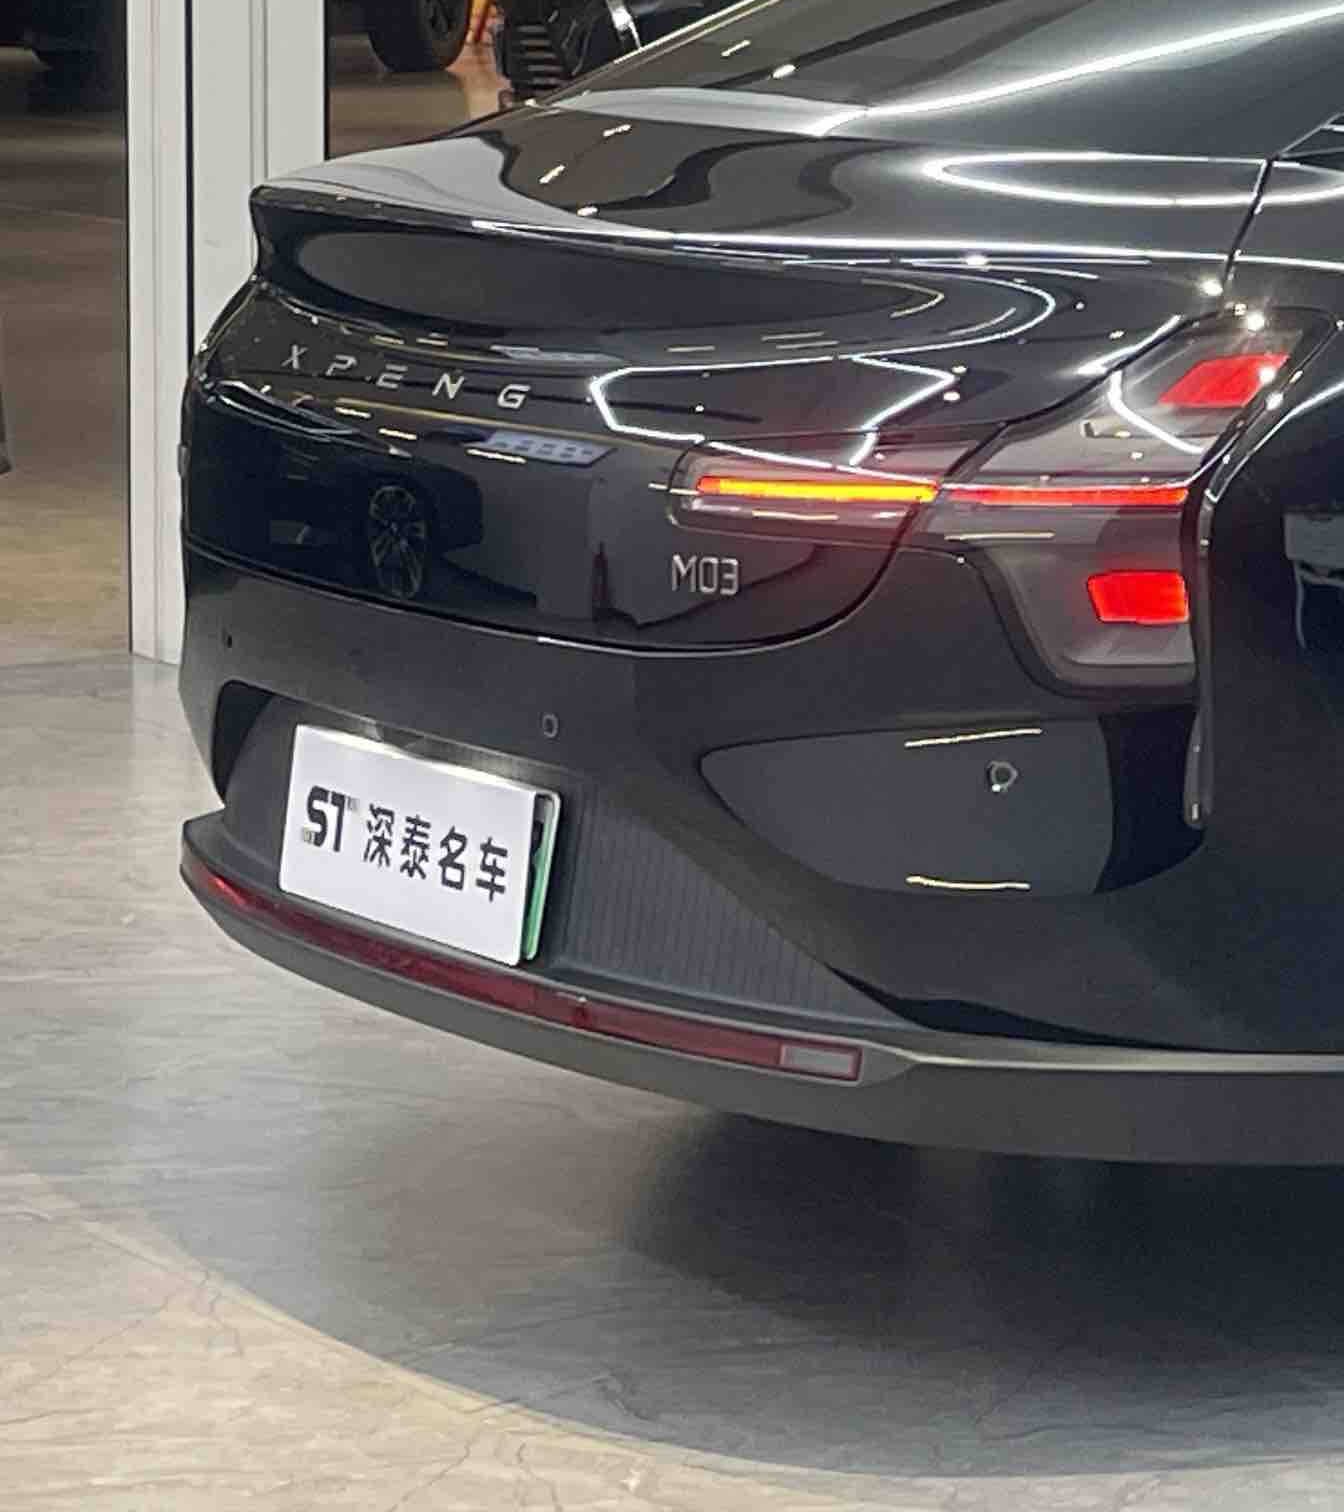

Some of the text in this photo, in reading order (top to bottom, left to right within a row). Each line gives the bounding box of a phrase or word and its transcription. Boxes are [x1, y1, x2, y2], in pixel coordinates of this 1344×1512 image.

[280, 343, 531, 410] XPENG
[671, 554, 740, 596] M03
[363, 803, 509, 902] 深泰名车
